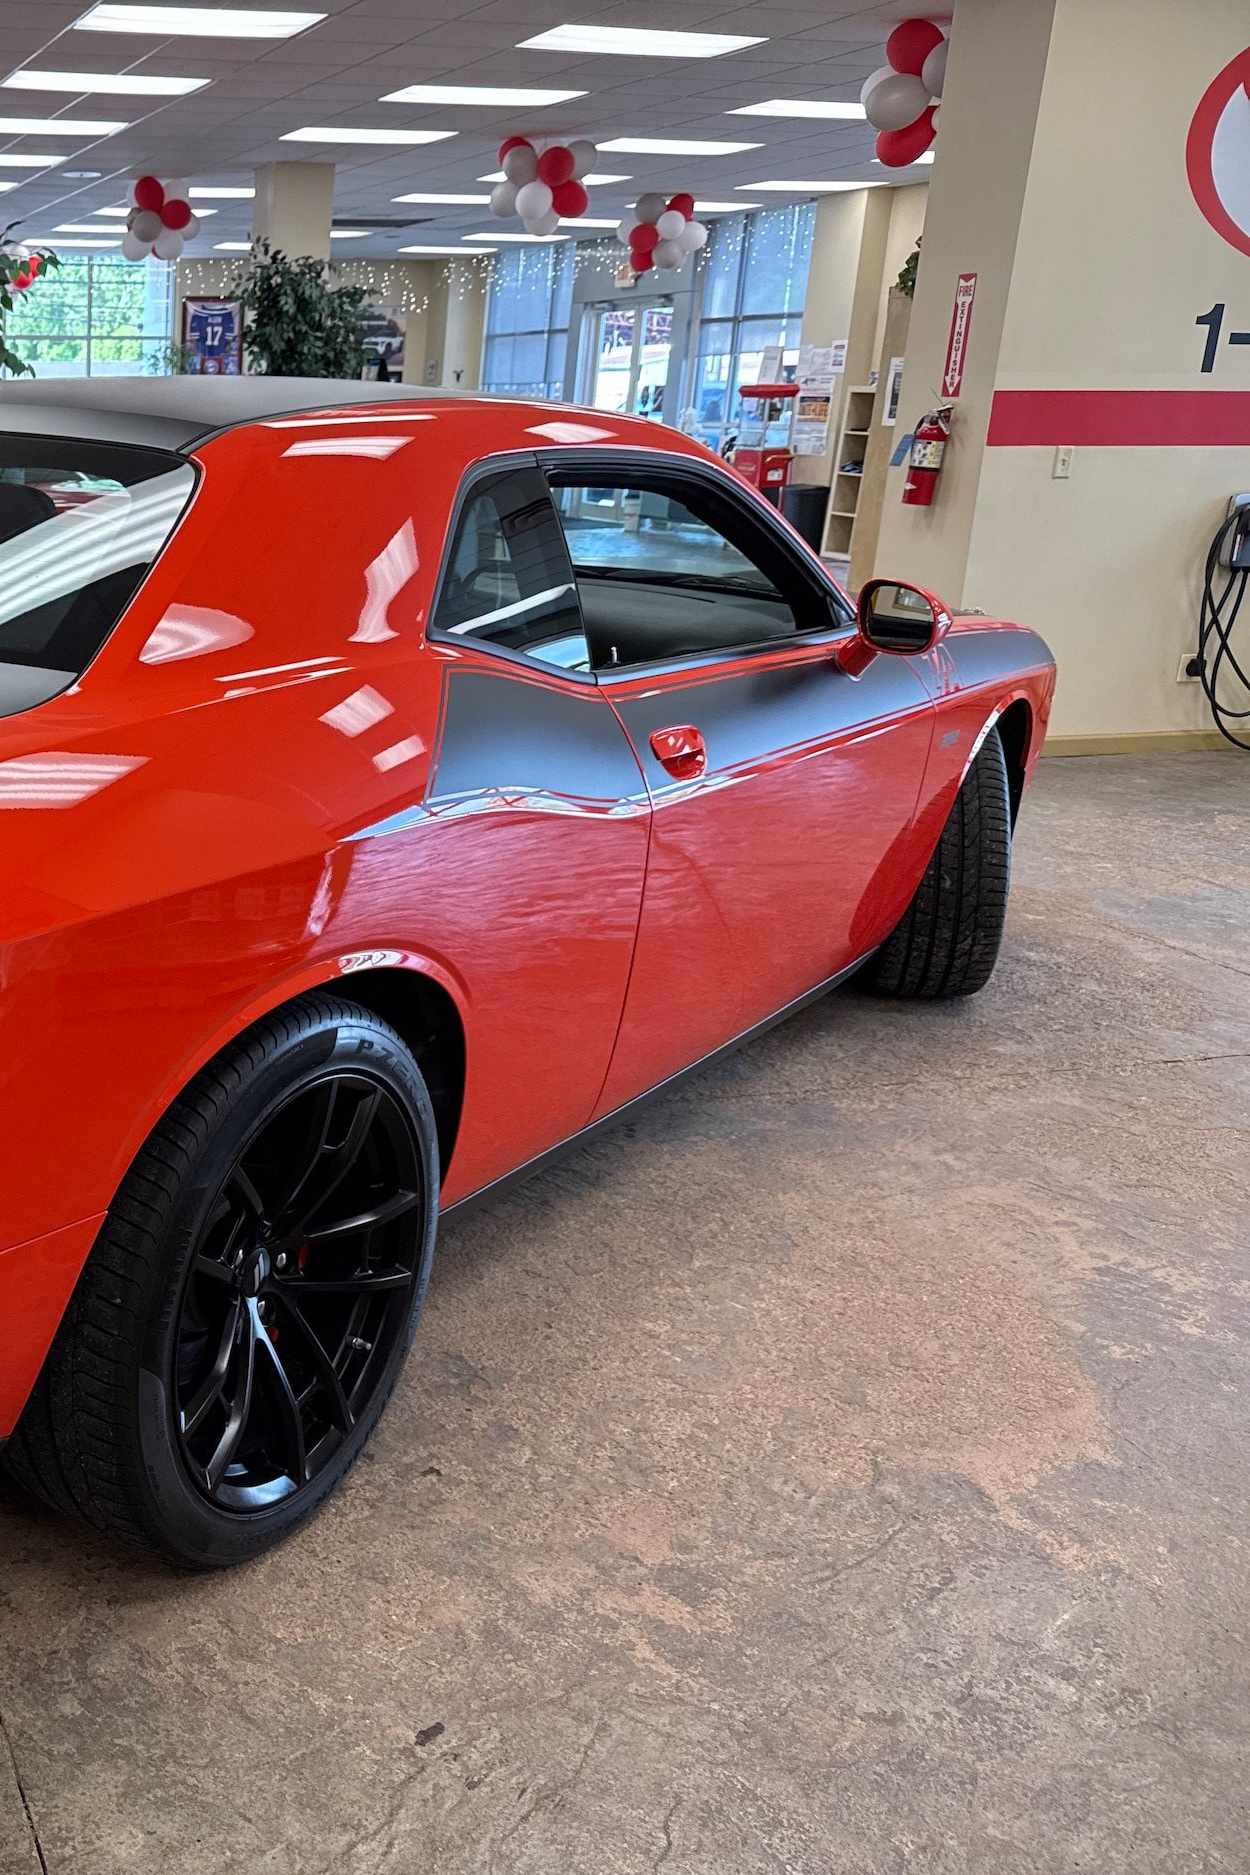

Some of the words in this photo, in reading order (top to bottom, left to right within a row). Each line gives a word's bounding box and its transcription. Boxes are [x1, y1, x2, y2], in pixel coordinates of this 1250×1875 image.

[959, 285, 973, 297] FIRE
[205, 326, 223, 346] 17
[949, 301, 966, 388] EXTINGUISHER
